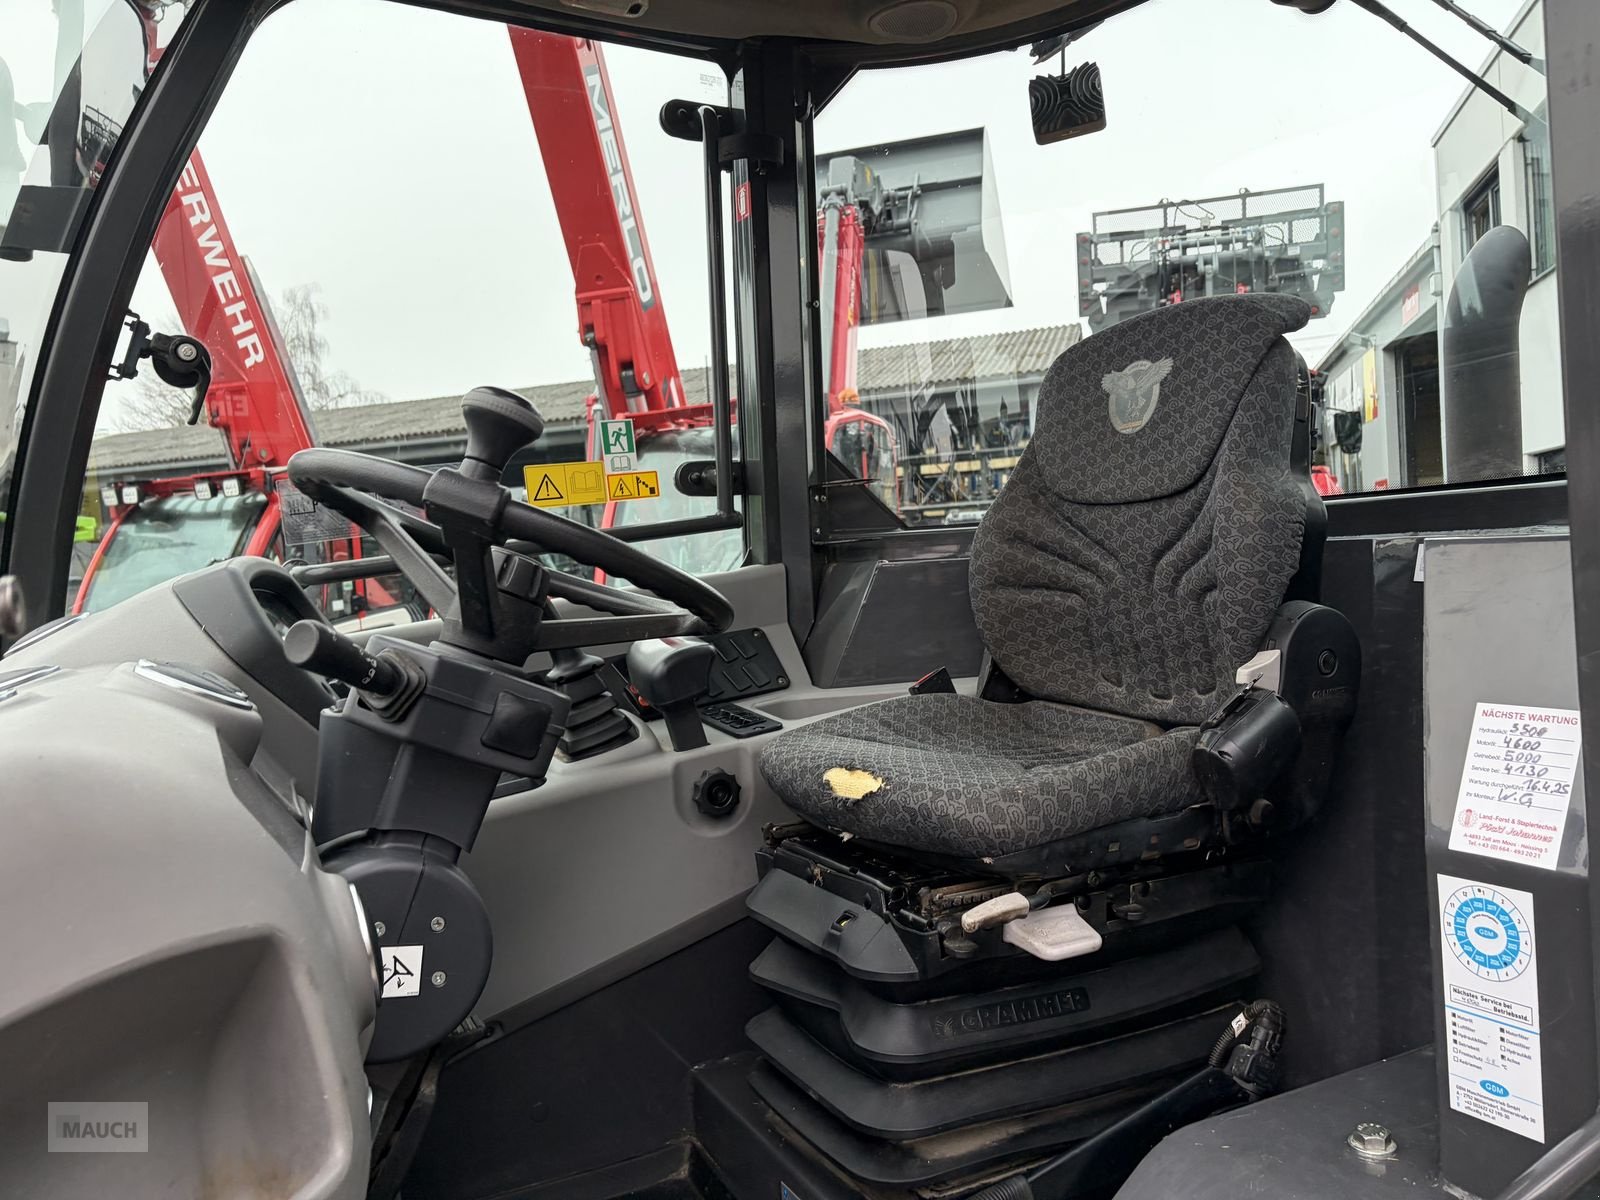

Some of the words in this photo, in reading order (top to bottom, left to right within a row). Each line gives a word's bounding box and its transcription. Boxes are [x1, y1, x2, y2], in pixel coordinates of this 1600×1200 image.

[586, 73, 652, 303] MERLO
[1481, 708, 1526, 721] NÄCHSTE
[1528, 713, 1578, 726] WARTUNG
[1503, 735, 1541, 751] 4600
[1503, 750, 1541, 764] 5000
[1504, 762, 1549, 777] 4130
[1480, 995, 1502, 1007] Service
[961, 991, 1082, 1031] GRAMMER
[1485, 1082, 1504, 1095] GDM
